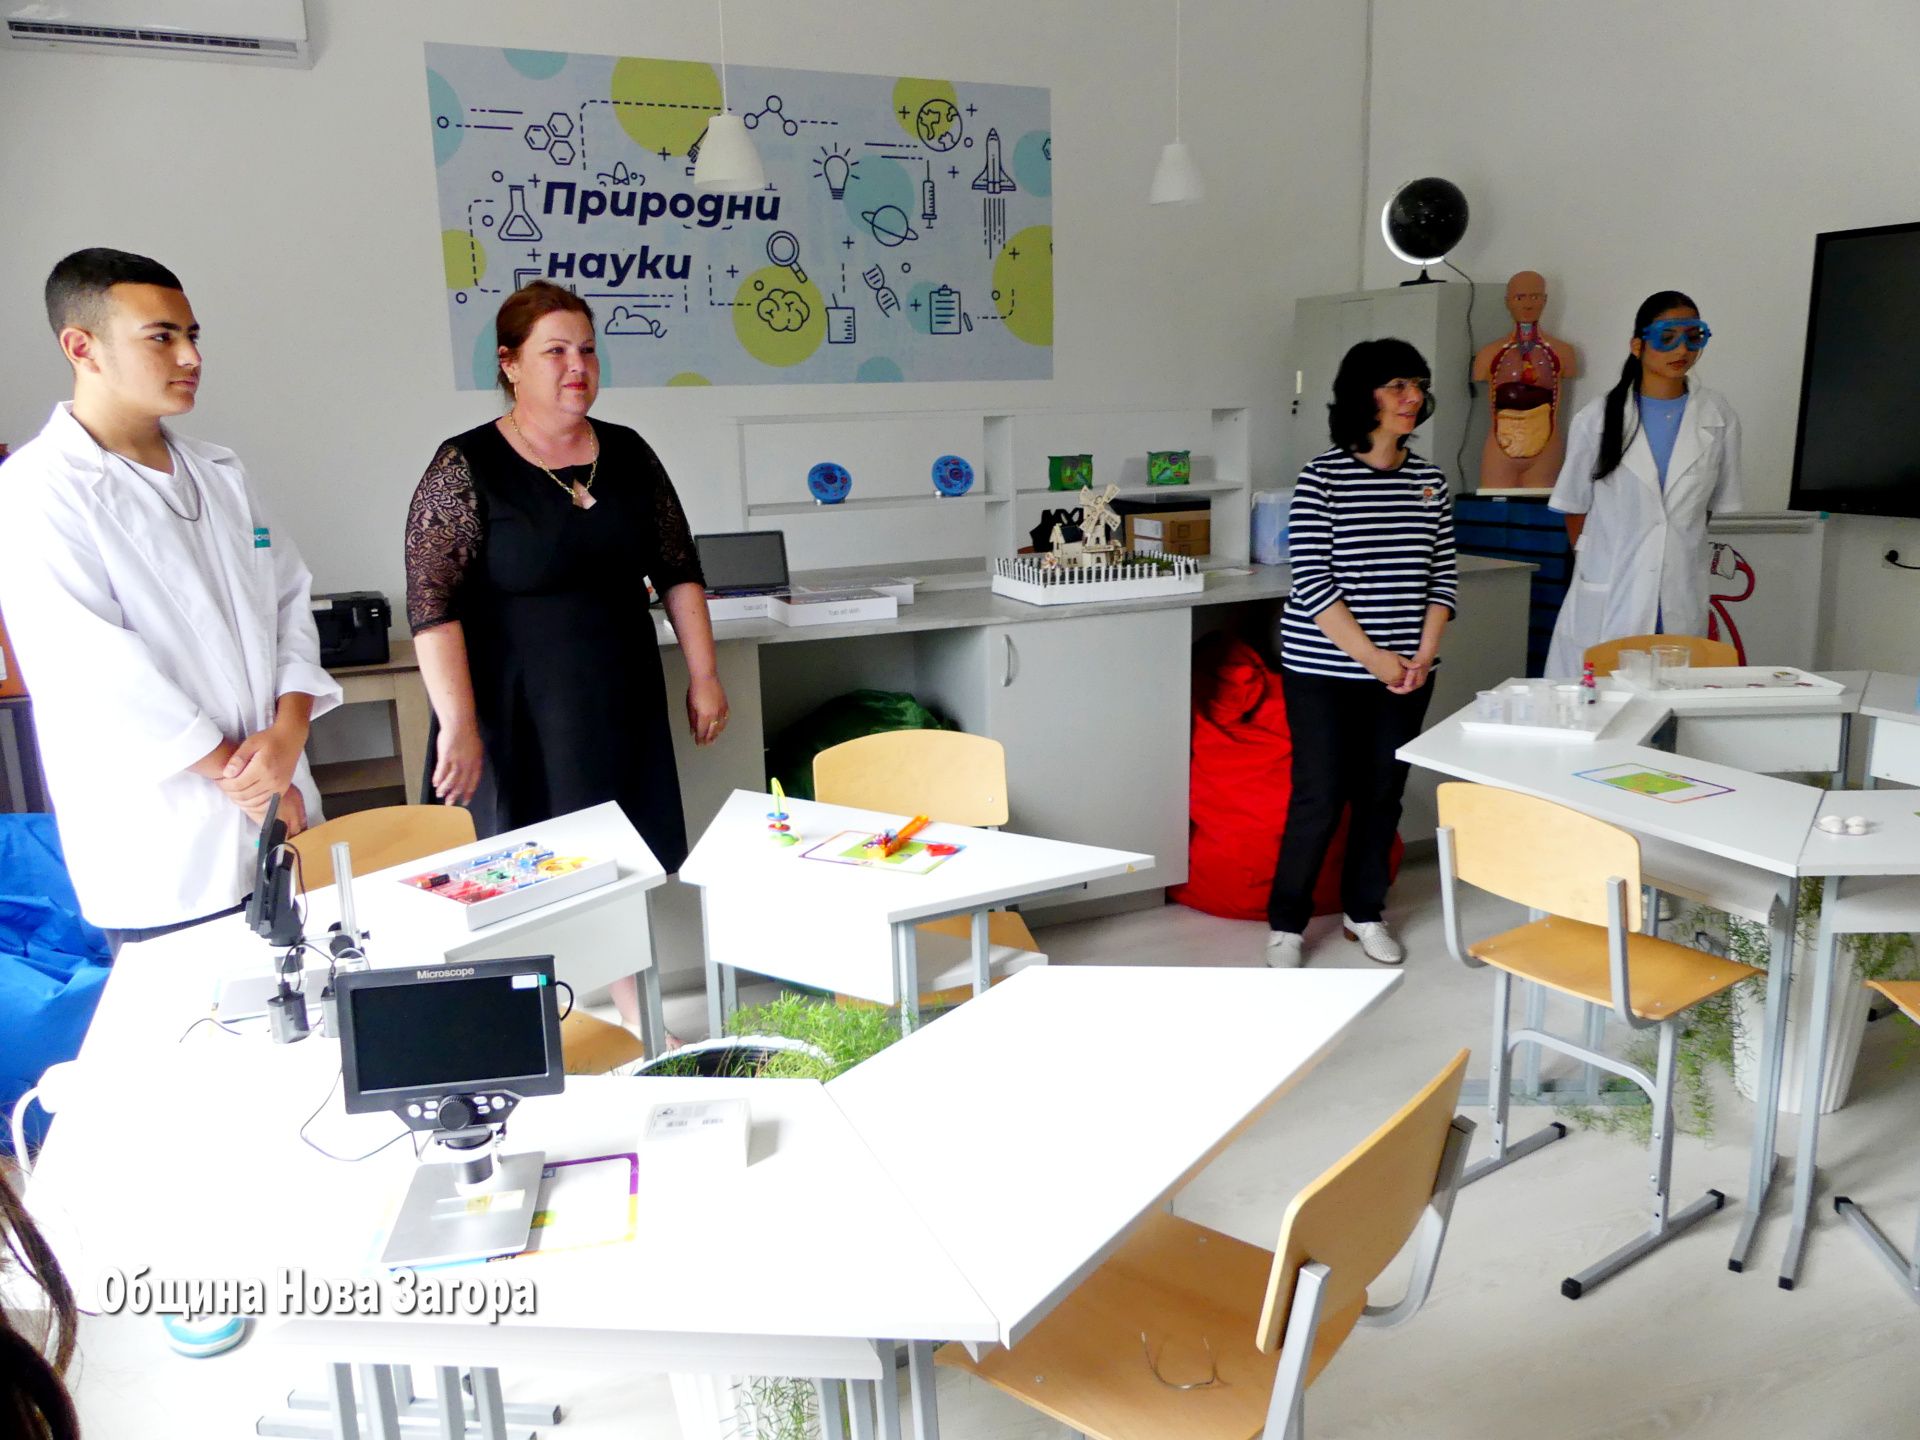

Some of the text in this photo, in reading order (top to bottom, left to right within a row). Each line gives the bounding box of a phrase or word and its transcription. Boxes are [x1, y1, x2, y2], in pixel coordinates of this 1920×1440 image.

[543, 181, 781, 228] Природни
[548, 245, 692, 287] науки
[416, 967, 475, 979] Microscope
